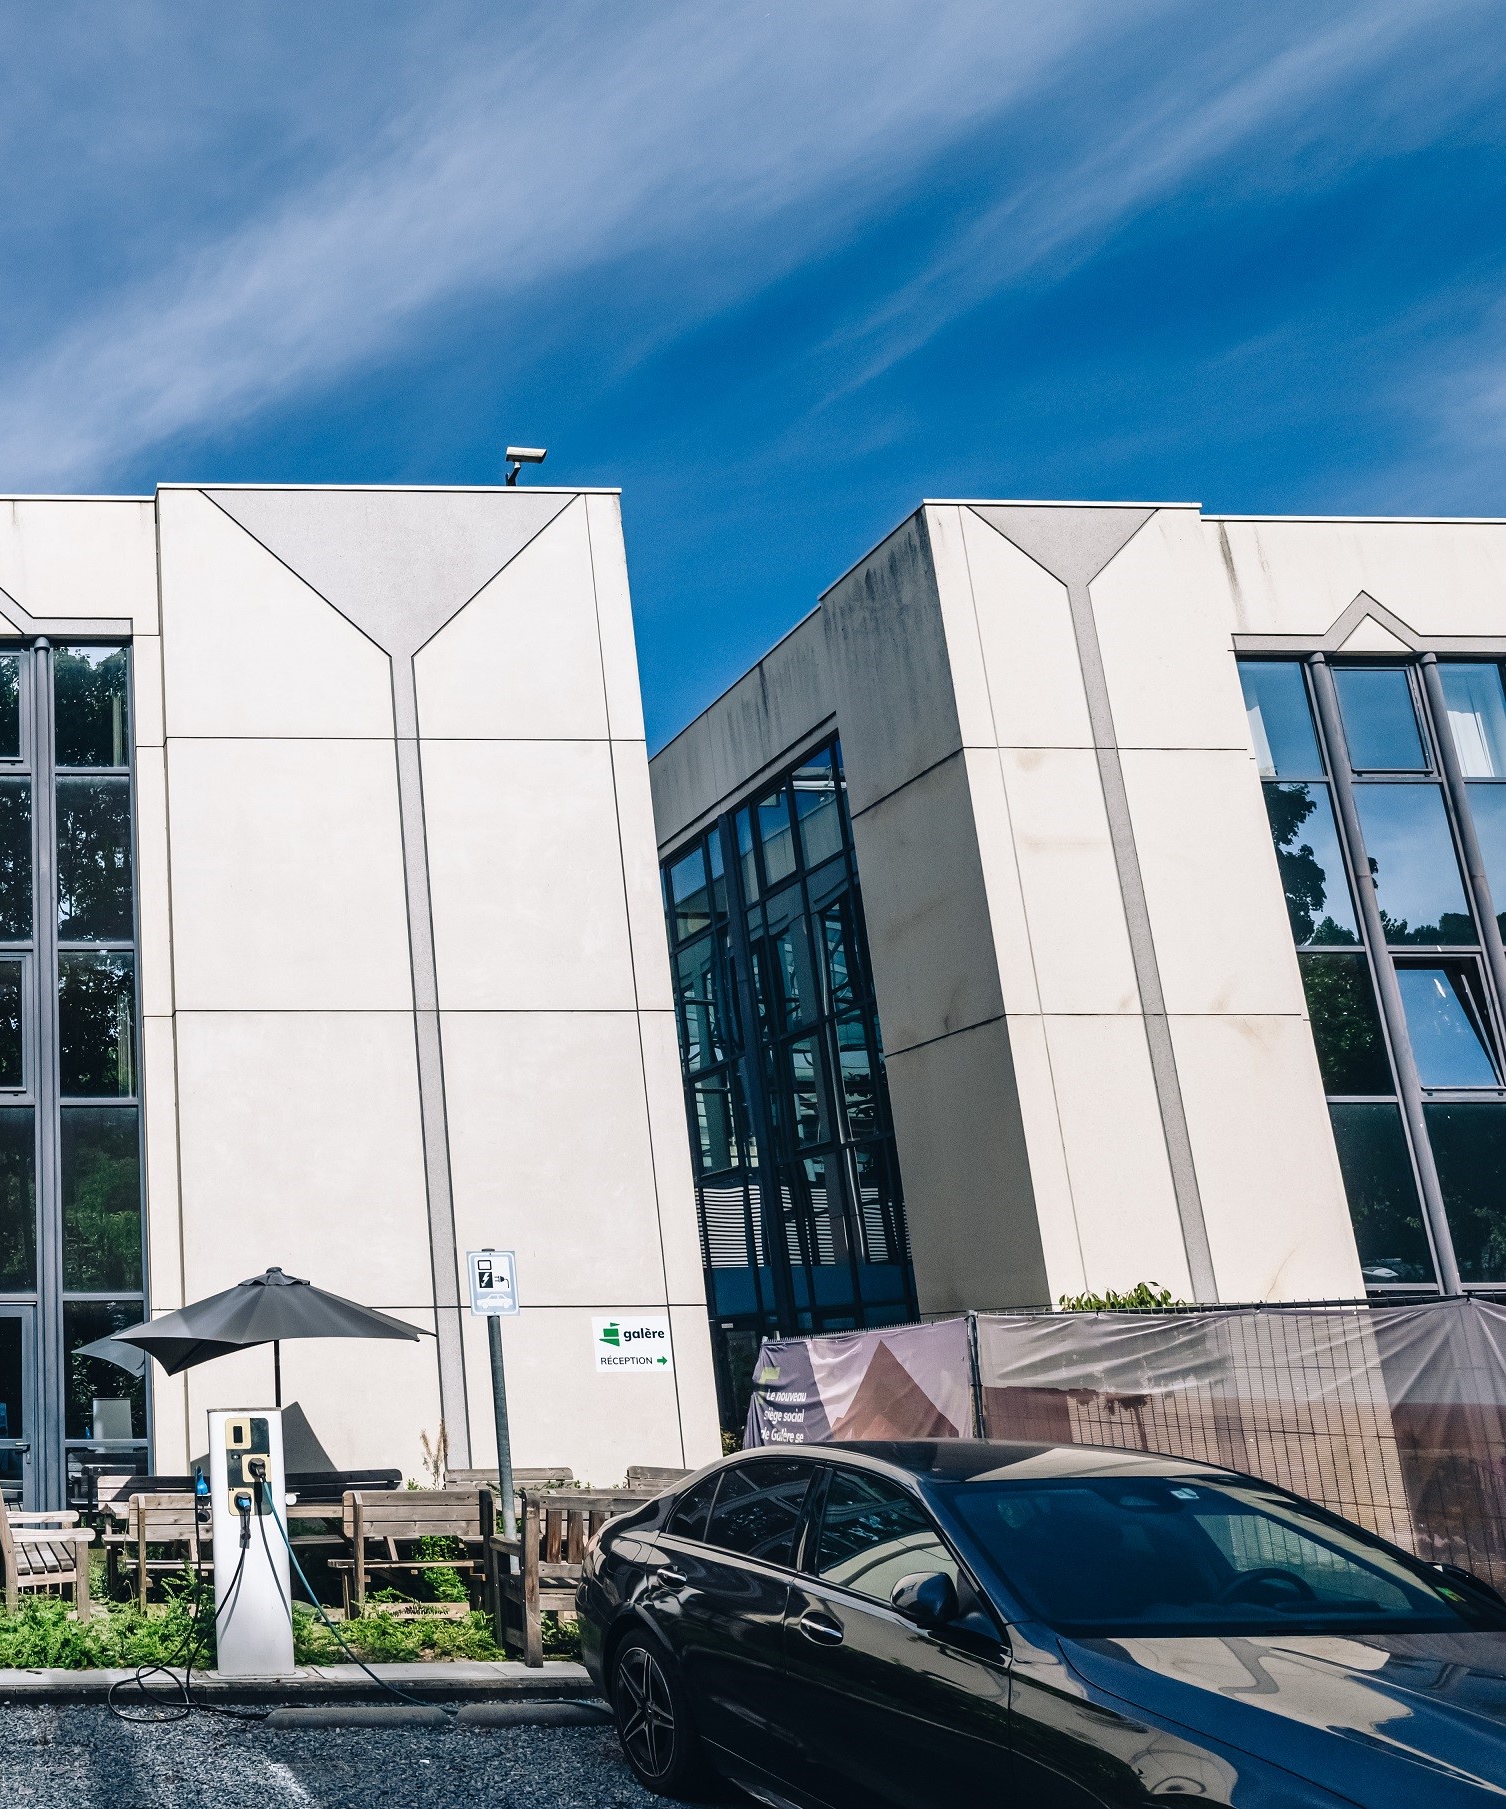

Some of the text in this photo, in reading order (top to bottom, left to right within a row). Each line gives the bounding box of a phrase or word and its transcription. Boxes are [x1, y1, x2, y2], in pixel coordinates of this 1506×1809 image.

[623, 1328, 665, 1341] galère
[600, 1355, 653, 1365] RÉCEPTION
[775, 1392, 807, 1401] nouveau
[763, 1406, 805, 1424] siège social
[795, 1433, 804, 1443] se
